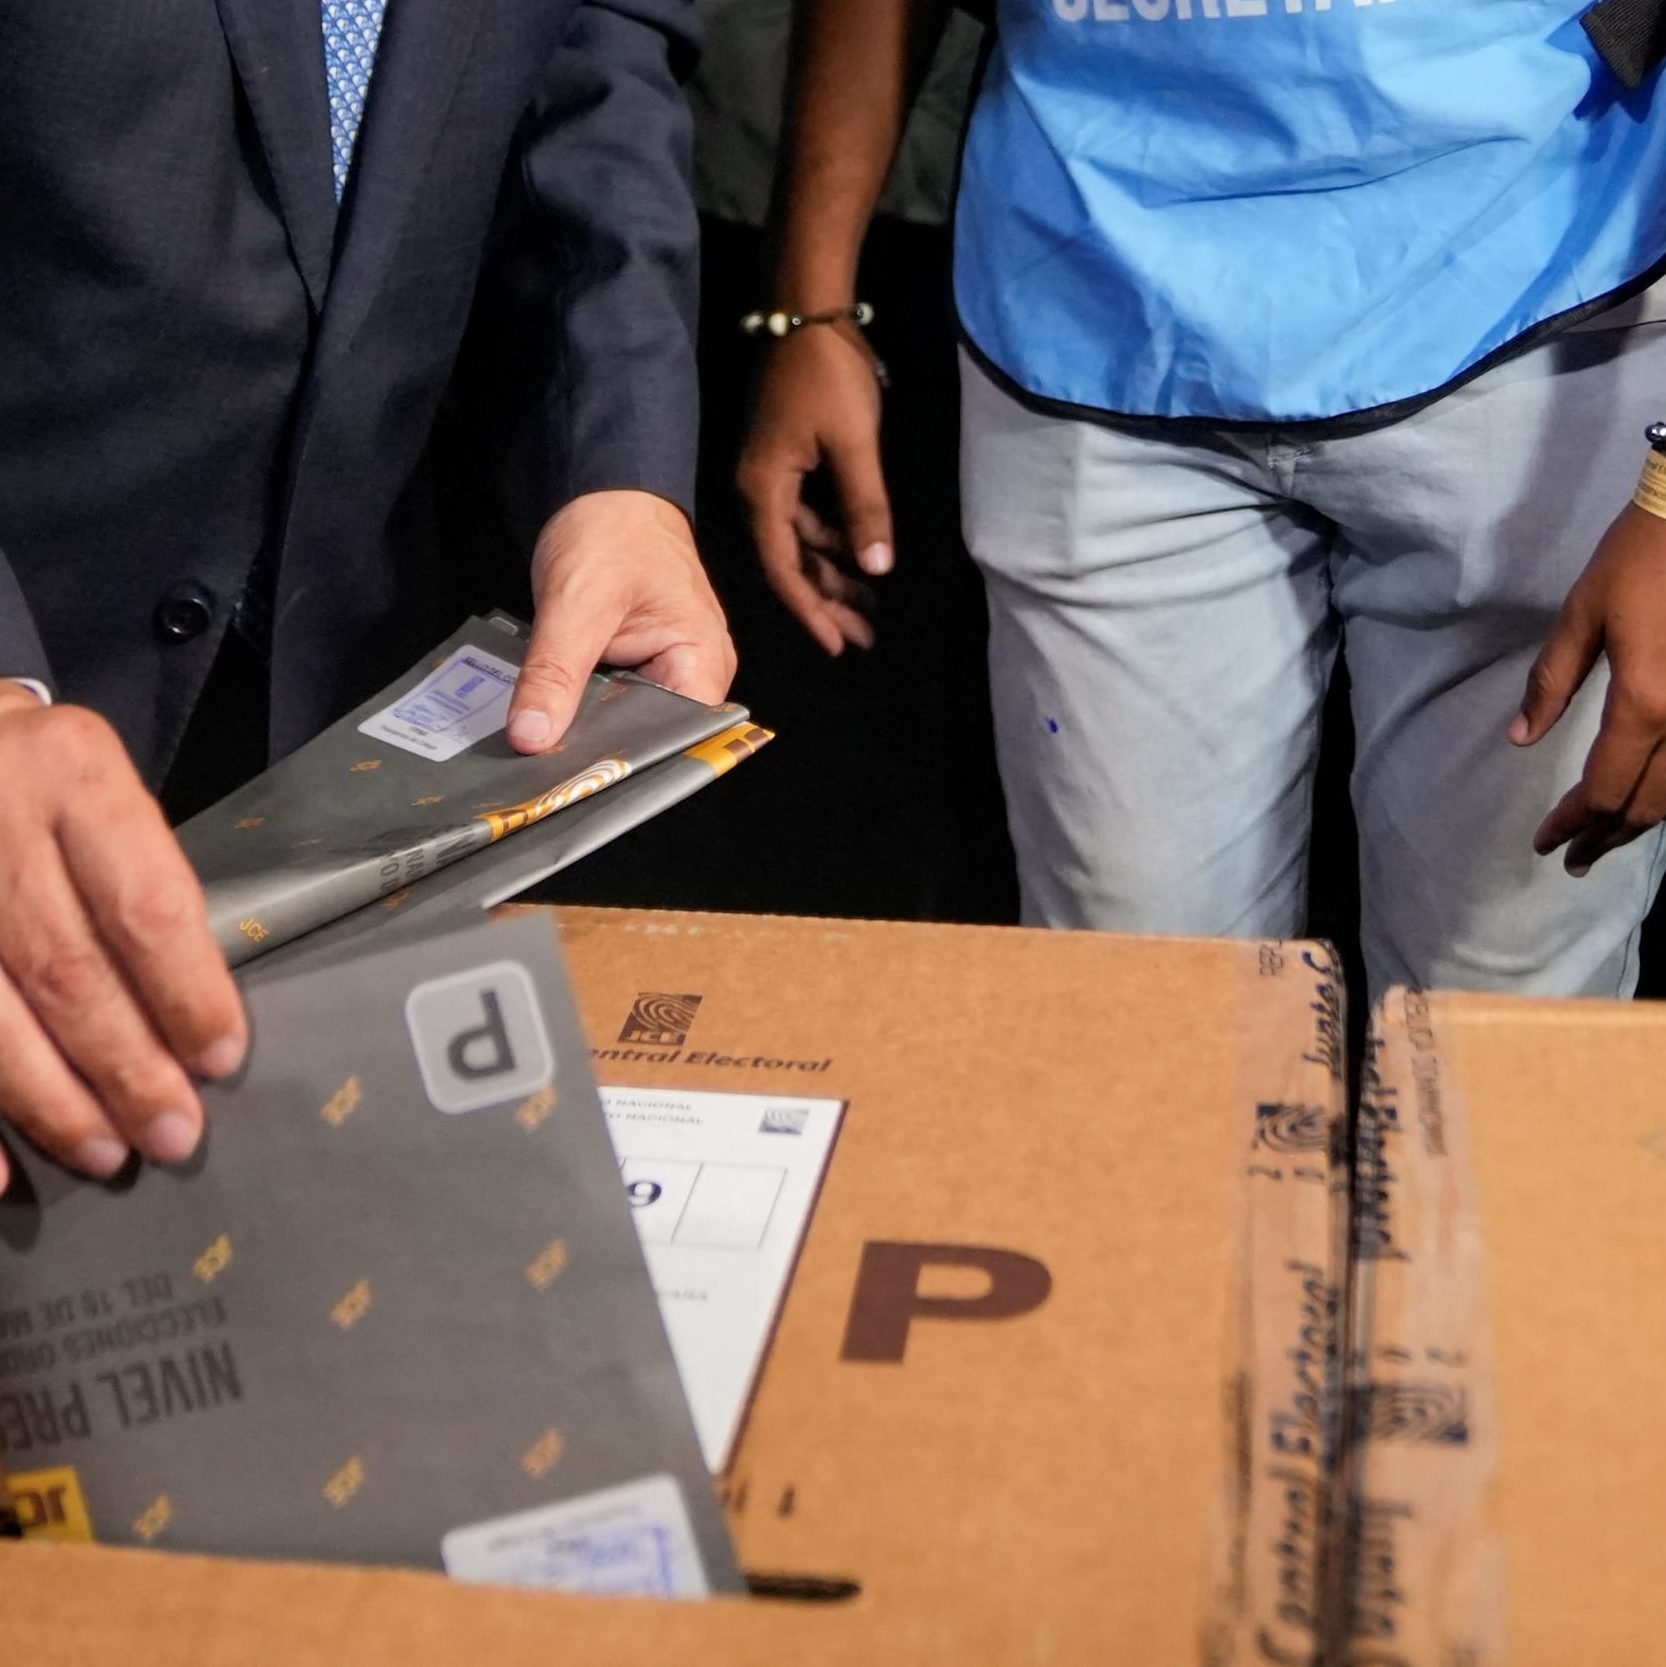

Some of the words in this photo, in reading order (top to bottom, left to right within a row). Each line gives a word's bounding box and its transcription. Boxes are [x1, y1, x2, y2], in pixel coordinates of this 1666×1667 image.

[238, 917, 271, 943] JCE
[445, 988, 518, 1081] P
[626, 1030, 683, 1045] JCE
[590, 1048, 681, 1065] entral
[683, 1050, 834, 1073] Electoral
[626, 1179, 663, 1209] 9
[839, 1240, 1052, 1363] P
[96, 1342, 244, 1432] NIVEL
[15, 1483, 66, 1525] JC
